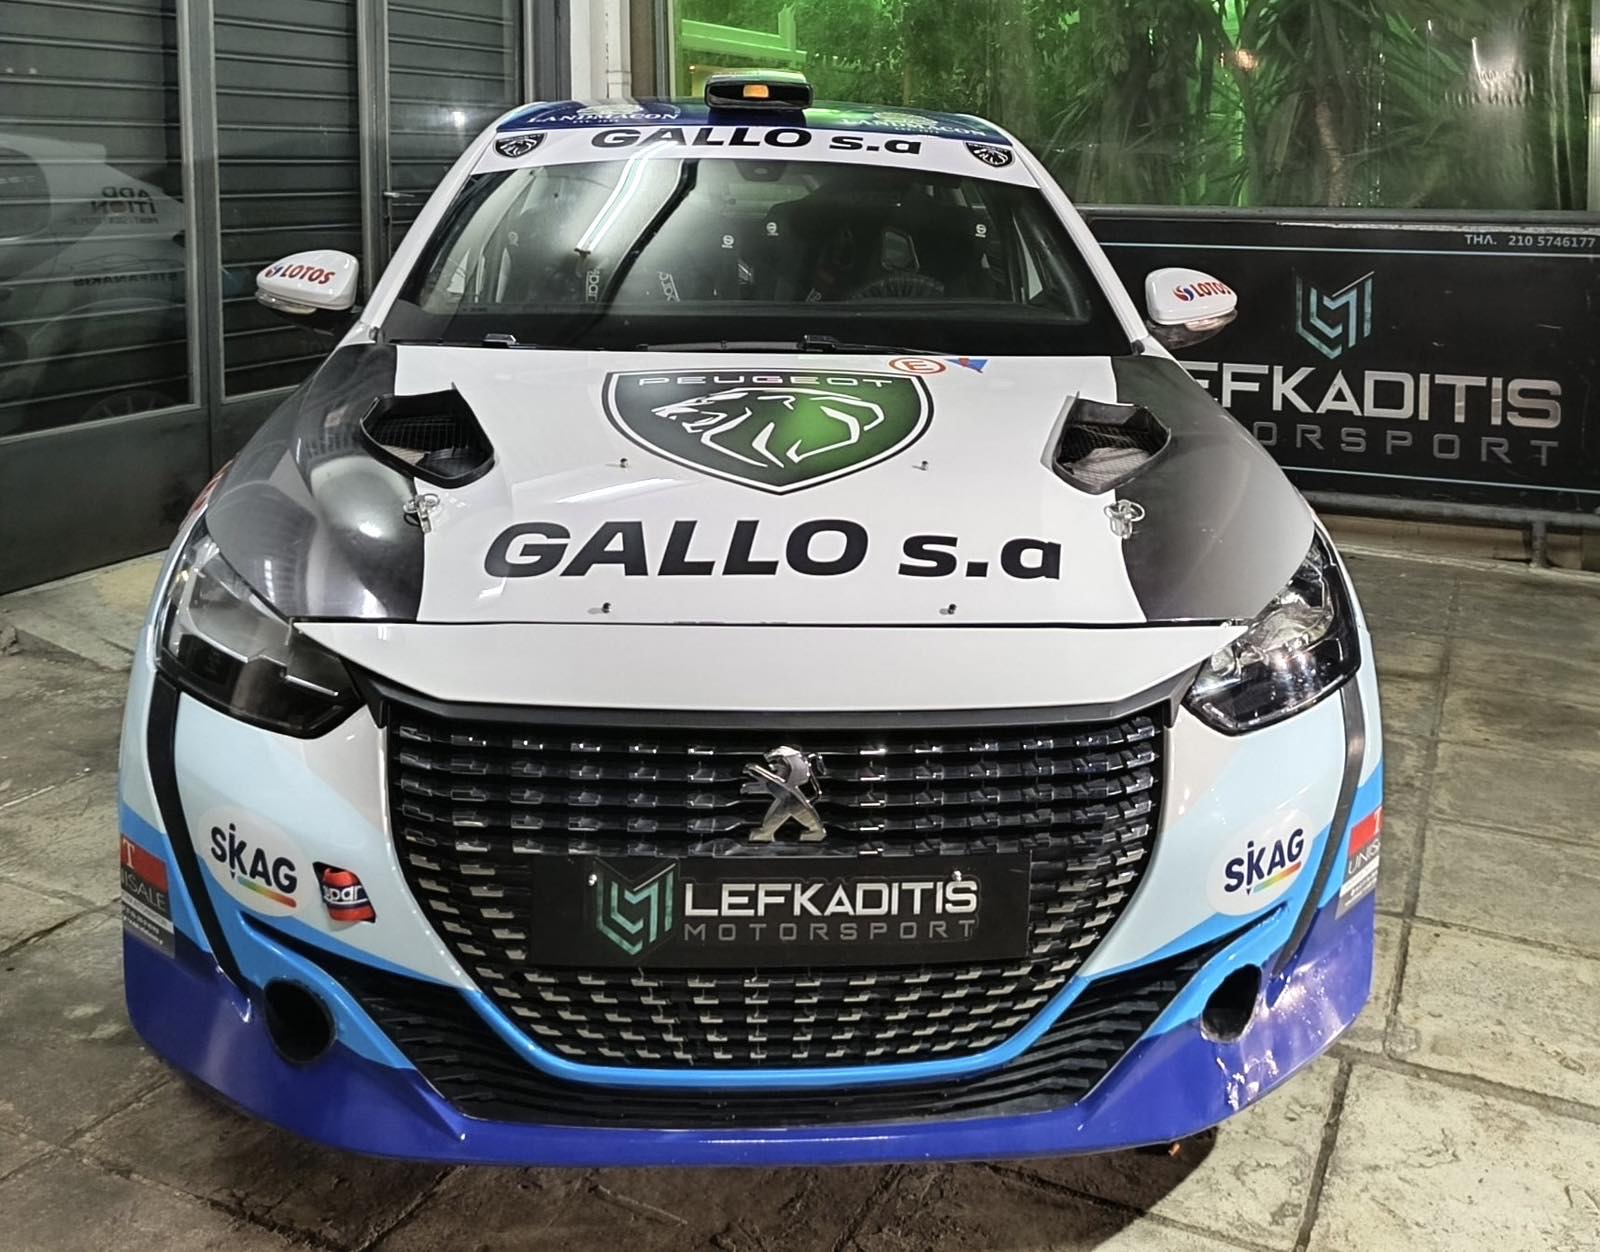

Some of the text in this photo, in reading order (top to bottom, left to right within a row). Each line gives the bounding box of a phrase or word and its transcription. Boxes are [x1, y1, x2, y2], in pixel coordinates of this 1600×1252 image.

[591, 127, 921, 154] GALLO s.a
[1508, 235, 1534, 246] 210
[1537, 236, 1596, 248] 5746177
[280, 264, 336, 284] LOTOS
[639, 375, 893, 387] PEUGEOT
[1180, 360, 1562, 429] EFKADITIS
[1252, 421, 1560, 466] ORSPORT
[484, 519, 1062, 580] GALLO s.a
[684, 881, 978, 917] LEFKADITIS
[684, 920, 976, 941] MOTORSPORT
